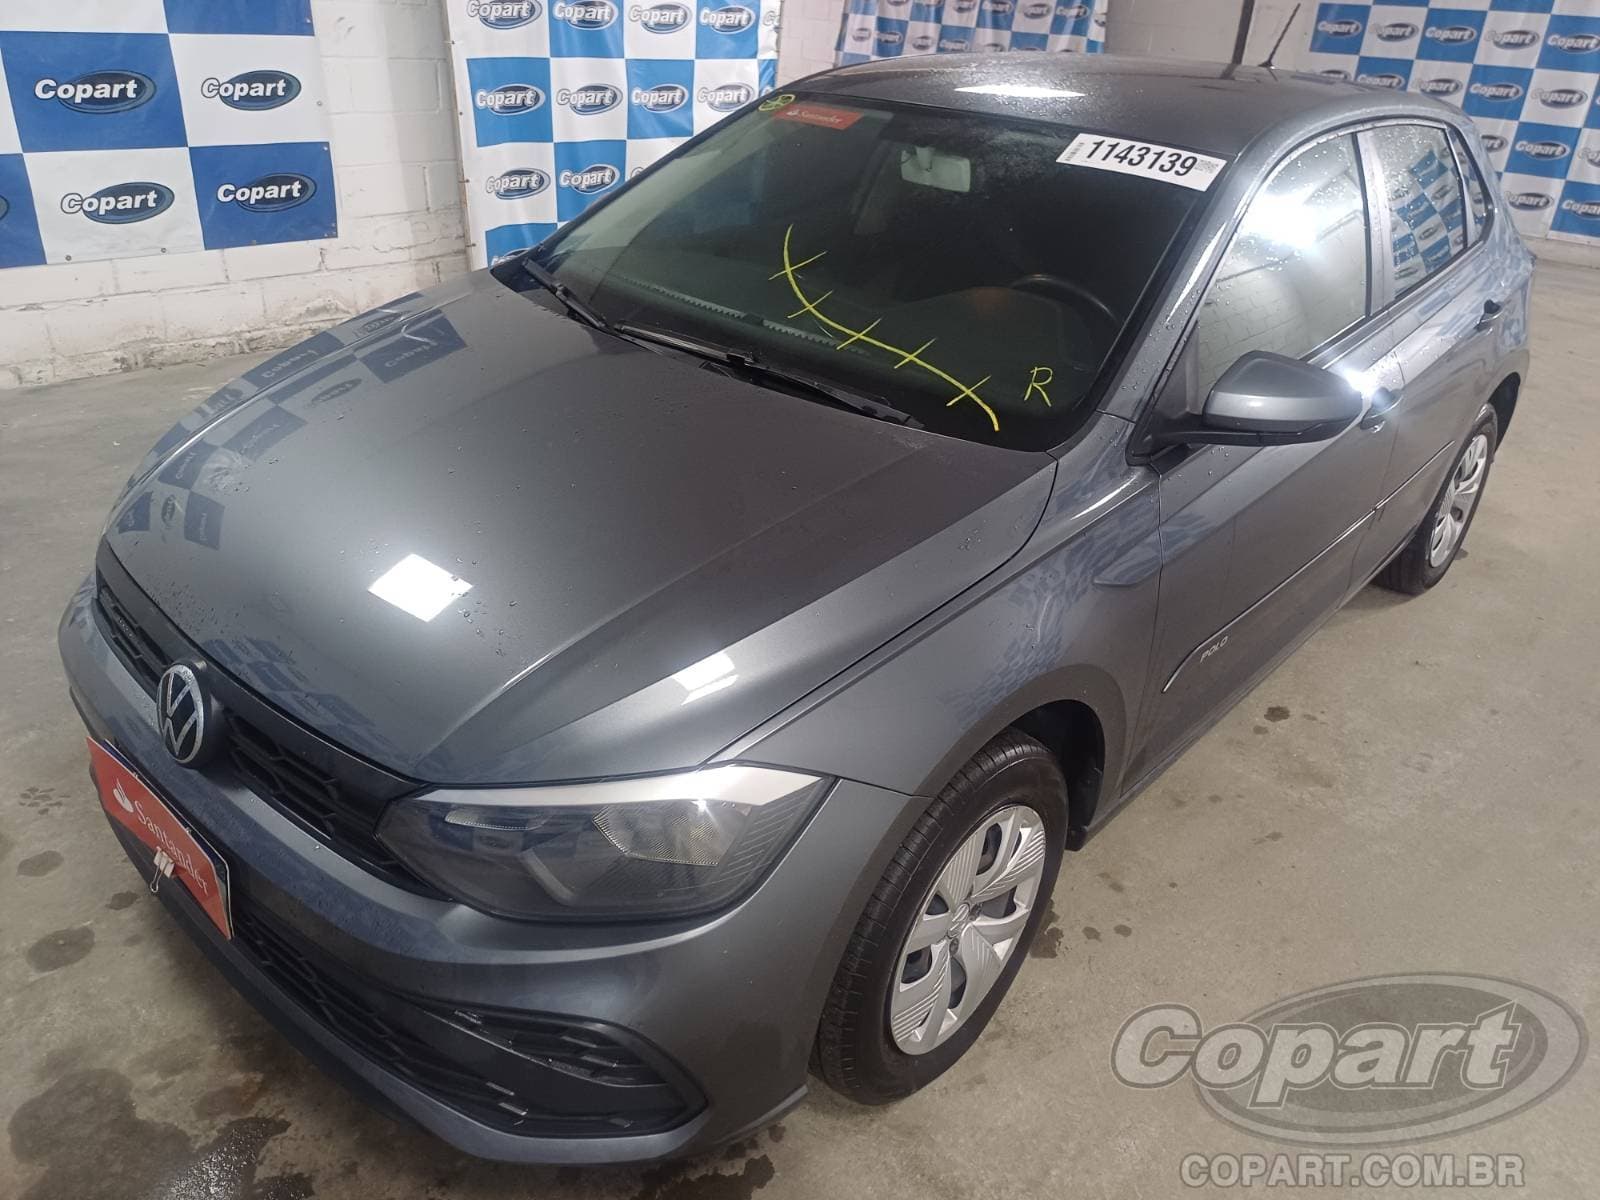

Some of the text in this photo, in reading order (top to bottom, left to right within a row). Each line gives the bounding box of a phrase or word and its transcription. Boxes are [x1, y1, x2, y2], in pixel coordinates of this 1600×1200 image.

[467, 0, 530, 22] Copart
[553, 2, 612, 25] Copart
[629, 5, 684, 28] Copart
[700, 7, 749, 29] Copart
[1318, 20, 1357, 35] Copart
[1425, 26, 1471, 41] Copart
[1547, 34, 1599, 49] Copart
[34, 78, 138, 103] Copart
[201, 77, 286, 101] Copart
[476, 87, 538, 111] Copart
[557, 87, 616, 109] Copart
[631, 87, 683, 107] Copart
[697, 87, 747, 106] Copart
[1469, 83, 1519, 99] Copart
[1086, 139, 1198, 177] 1143139
[1515, 140, 1564, 156] Copart
[486, 172, 541, 194] Copart
[560, 168, 612, 191] Copart
[217, 180, 301, 203] Copart
[61, 190, 157, 216] Copart
[1562, 199, 1600, 215] Copar
[1023, 366, 1053, 407] R
[134, 800, 209, 897] Santander
